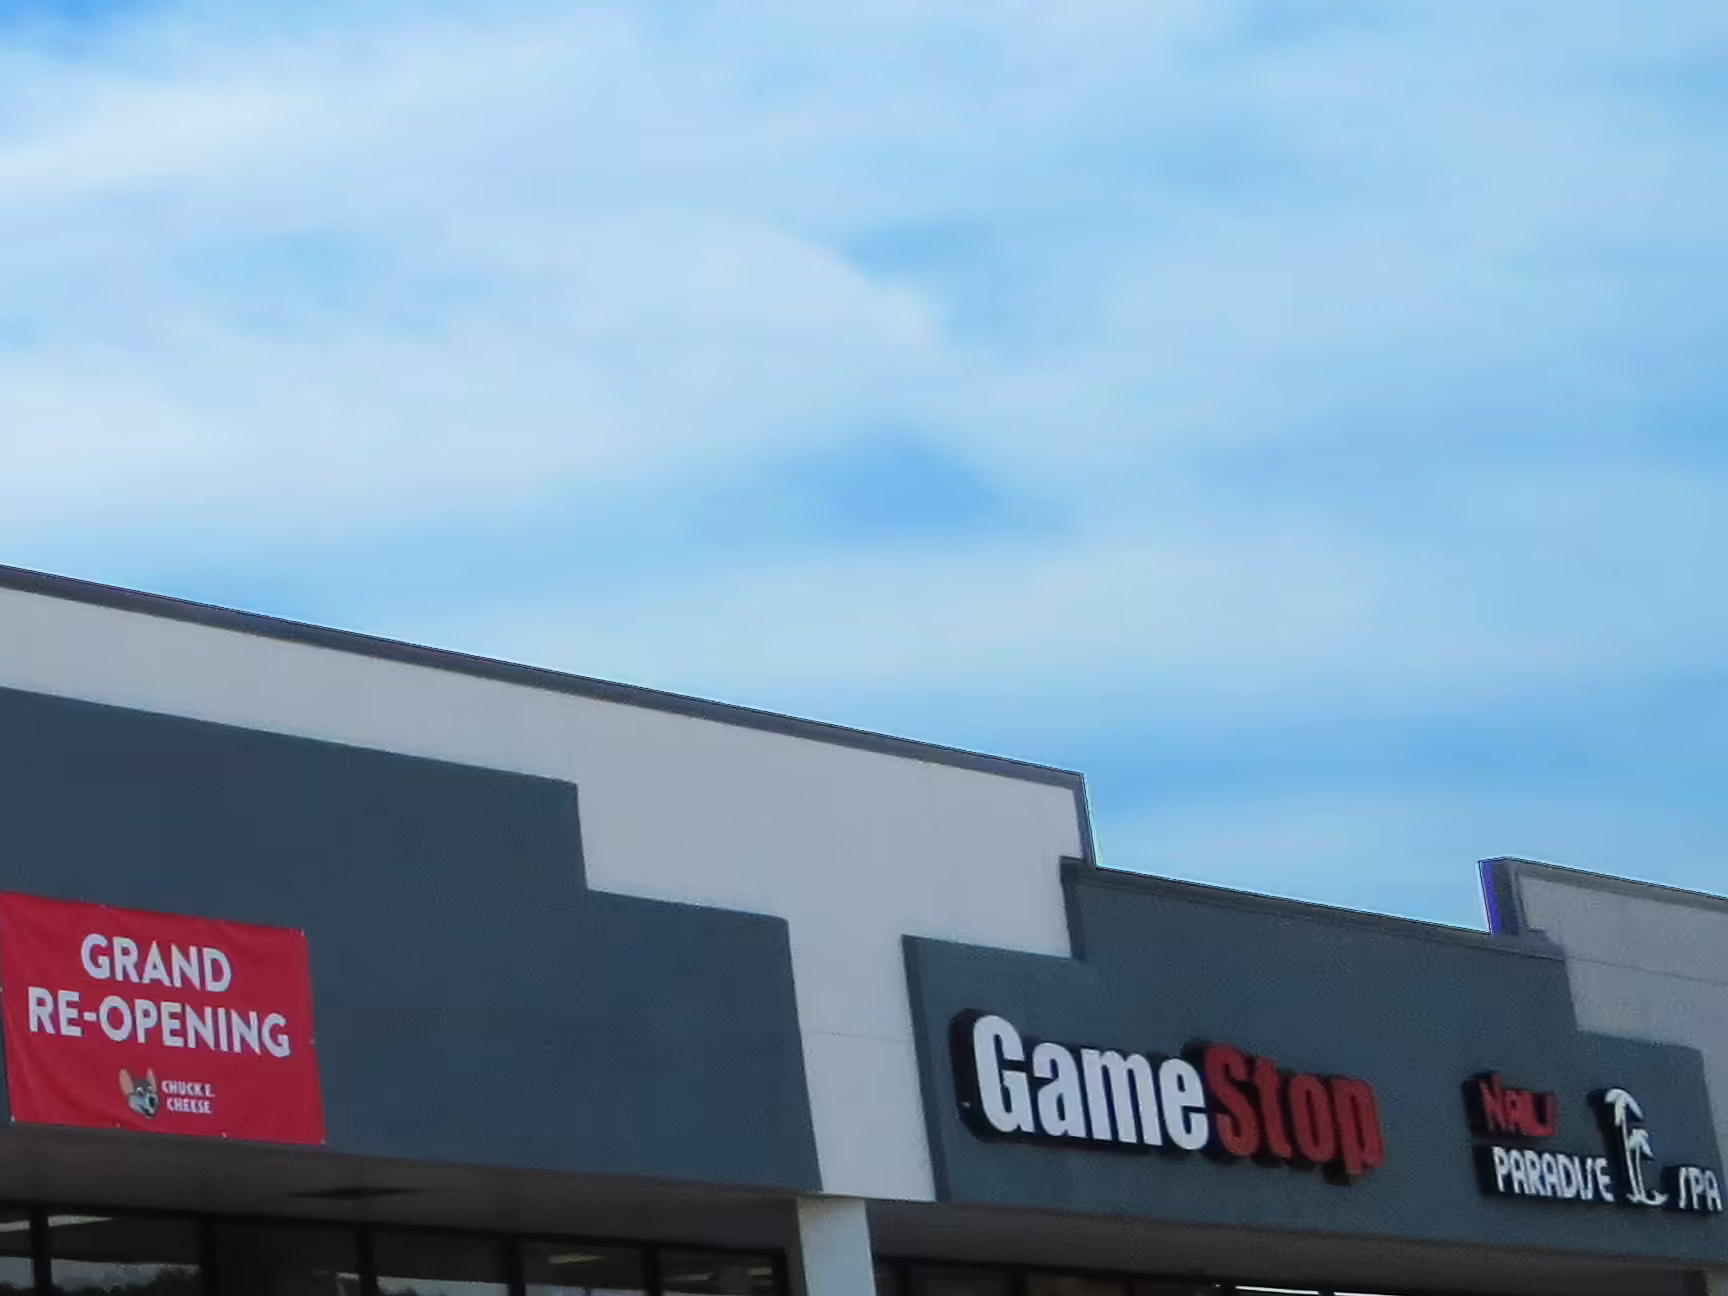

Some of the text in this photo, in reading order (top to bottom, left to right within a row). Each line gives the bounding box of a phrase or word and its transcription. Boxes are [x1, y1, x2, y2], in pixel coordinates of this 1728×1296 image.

[81, 933, 232, 993] GRAND
[28, 986, 292, 1059] RE-OPENING
[161, 1080, 204, 1096] CHUCK
[167, 1097, 213, 1115] CHEESE
[966, 1012, 1384, 1176] GameStop
[1491, 1146, 1723, 1212] PARADISE SPA
